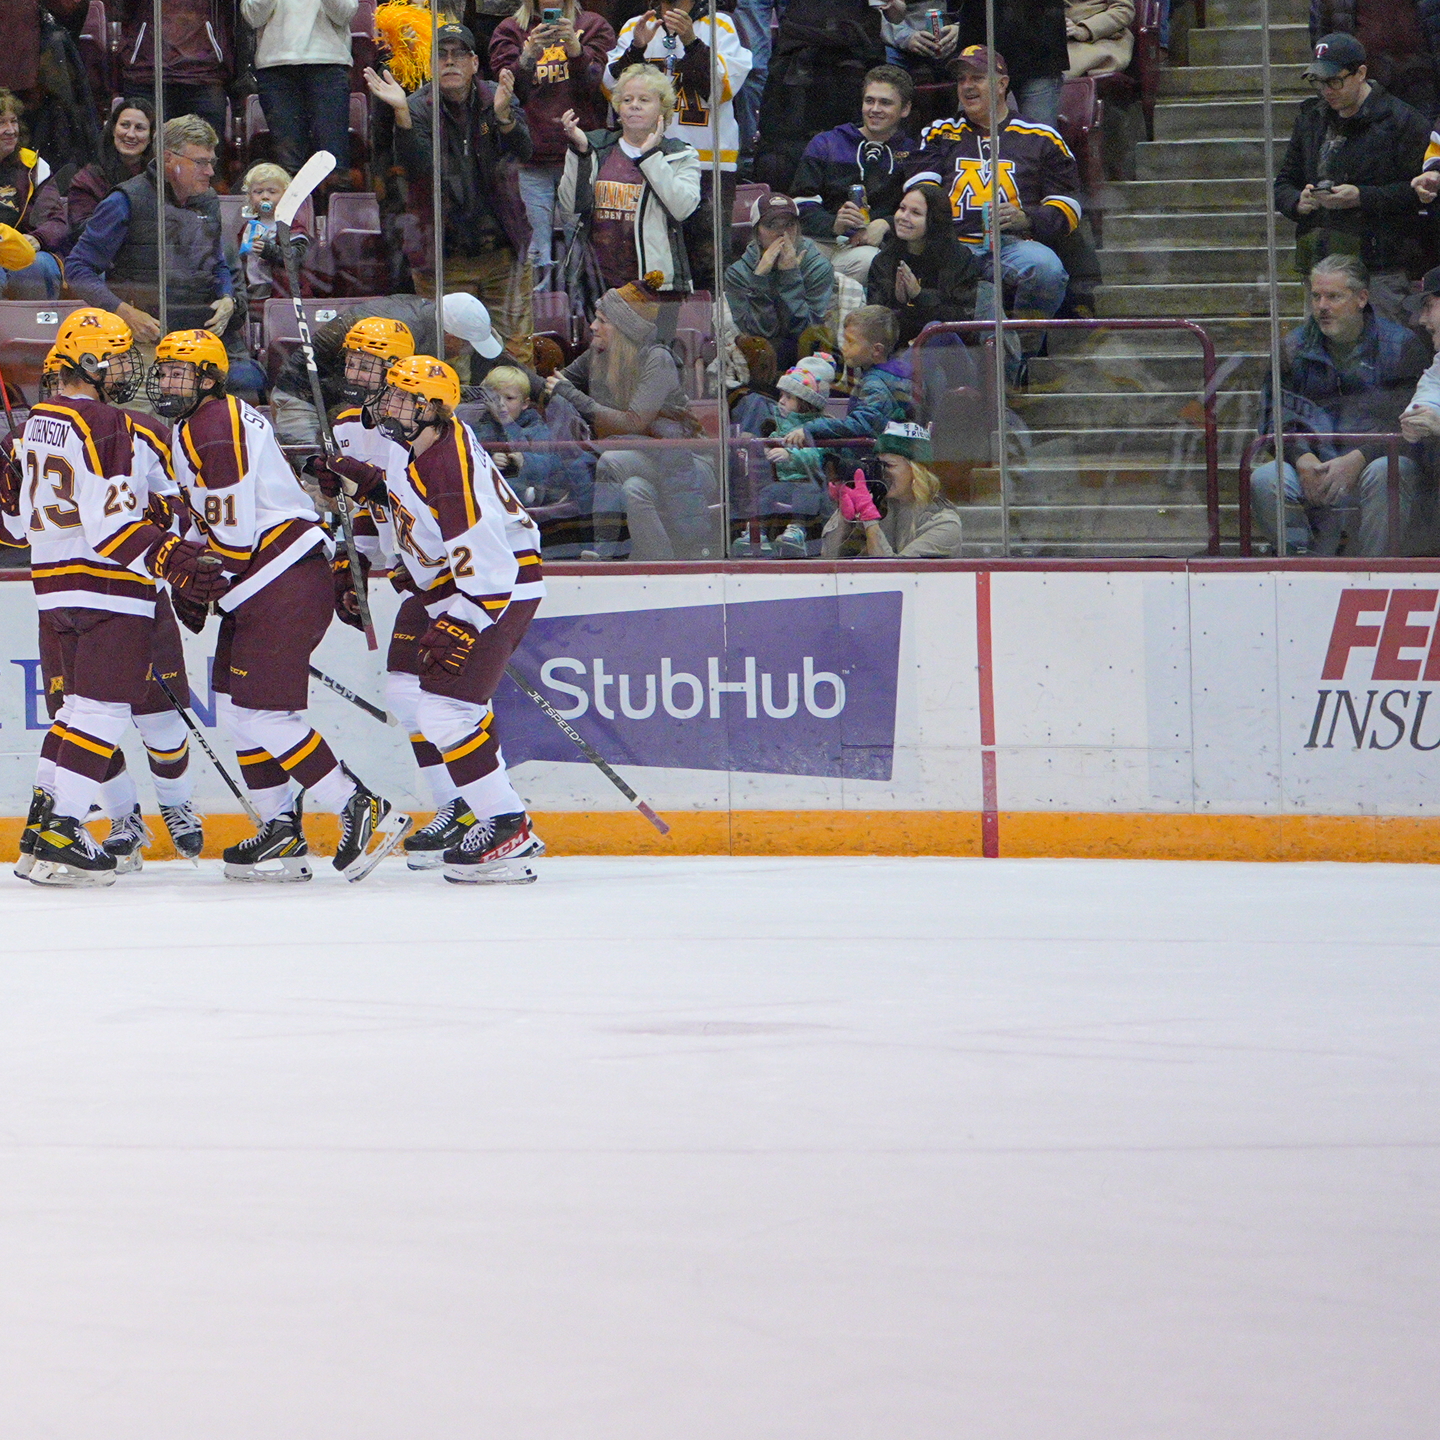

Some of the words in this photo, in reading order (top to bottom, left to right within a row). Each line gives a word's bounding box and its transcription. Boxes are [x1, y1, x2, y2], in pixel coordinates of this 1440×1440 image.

[949, 158, 1021, 221] M
[79, 315, 102, 329] M
[193, 329, 212, 341] M
[293, 296, 319, 373] CCM
[426, 365, 448, 379] M
[28, 419, 71, 449] JOHNSON
[104, 482, 138, 517] 23
[204, 495, 238, 527] 81
[154, 535, 182, 577] CCM
[451, 546, 476, 579] 2
[393, 632, 416, 642] CCM
[435, 619, 476, 646] CCM
[1321, 588, 1440, 682] FE
[321, 673, 356, 701] CCM
[539, 654, 847, 722] StubHub
[526, 689, 580, 742] JETSPEED
[483, 831, 524, 864] CCM
